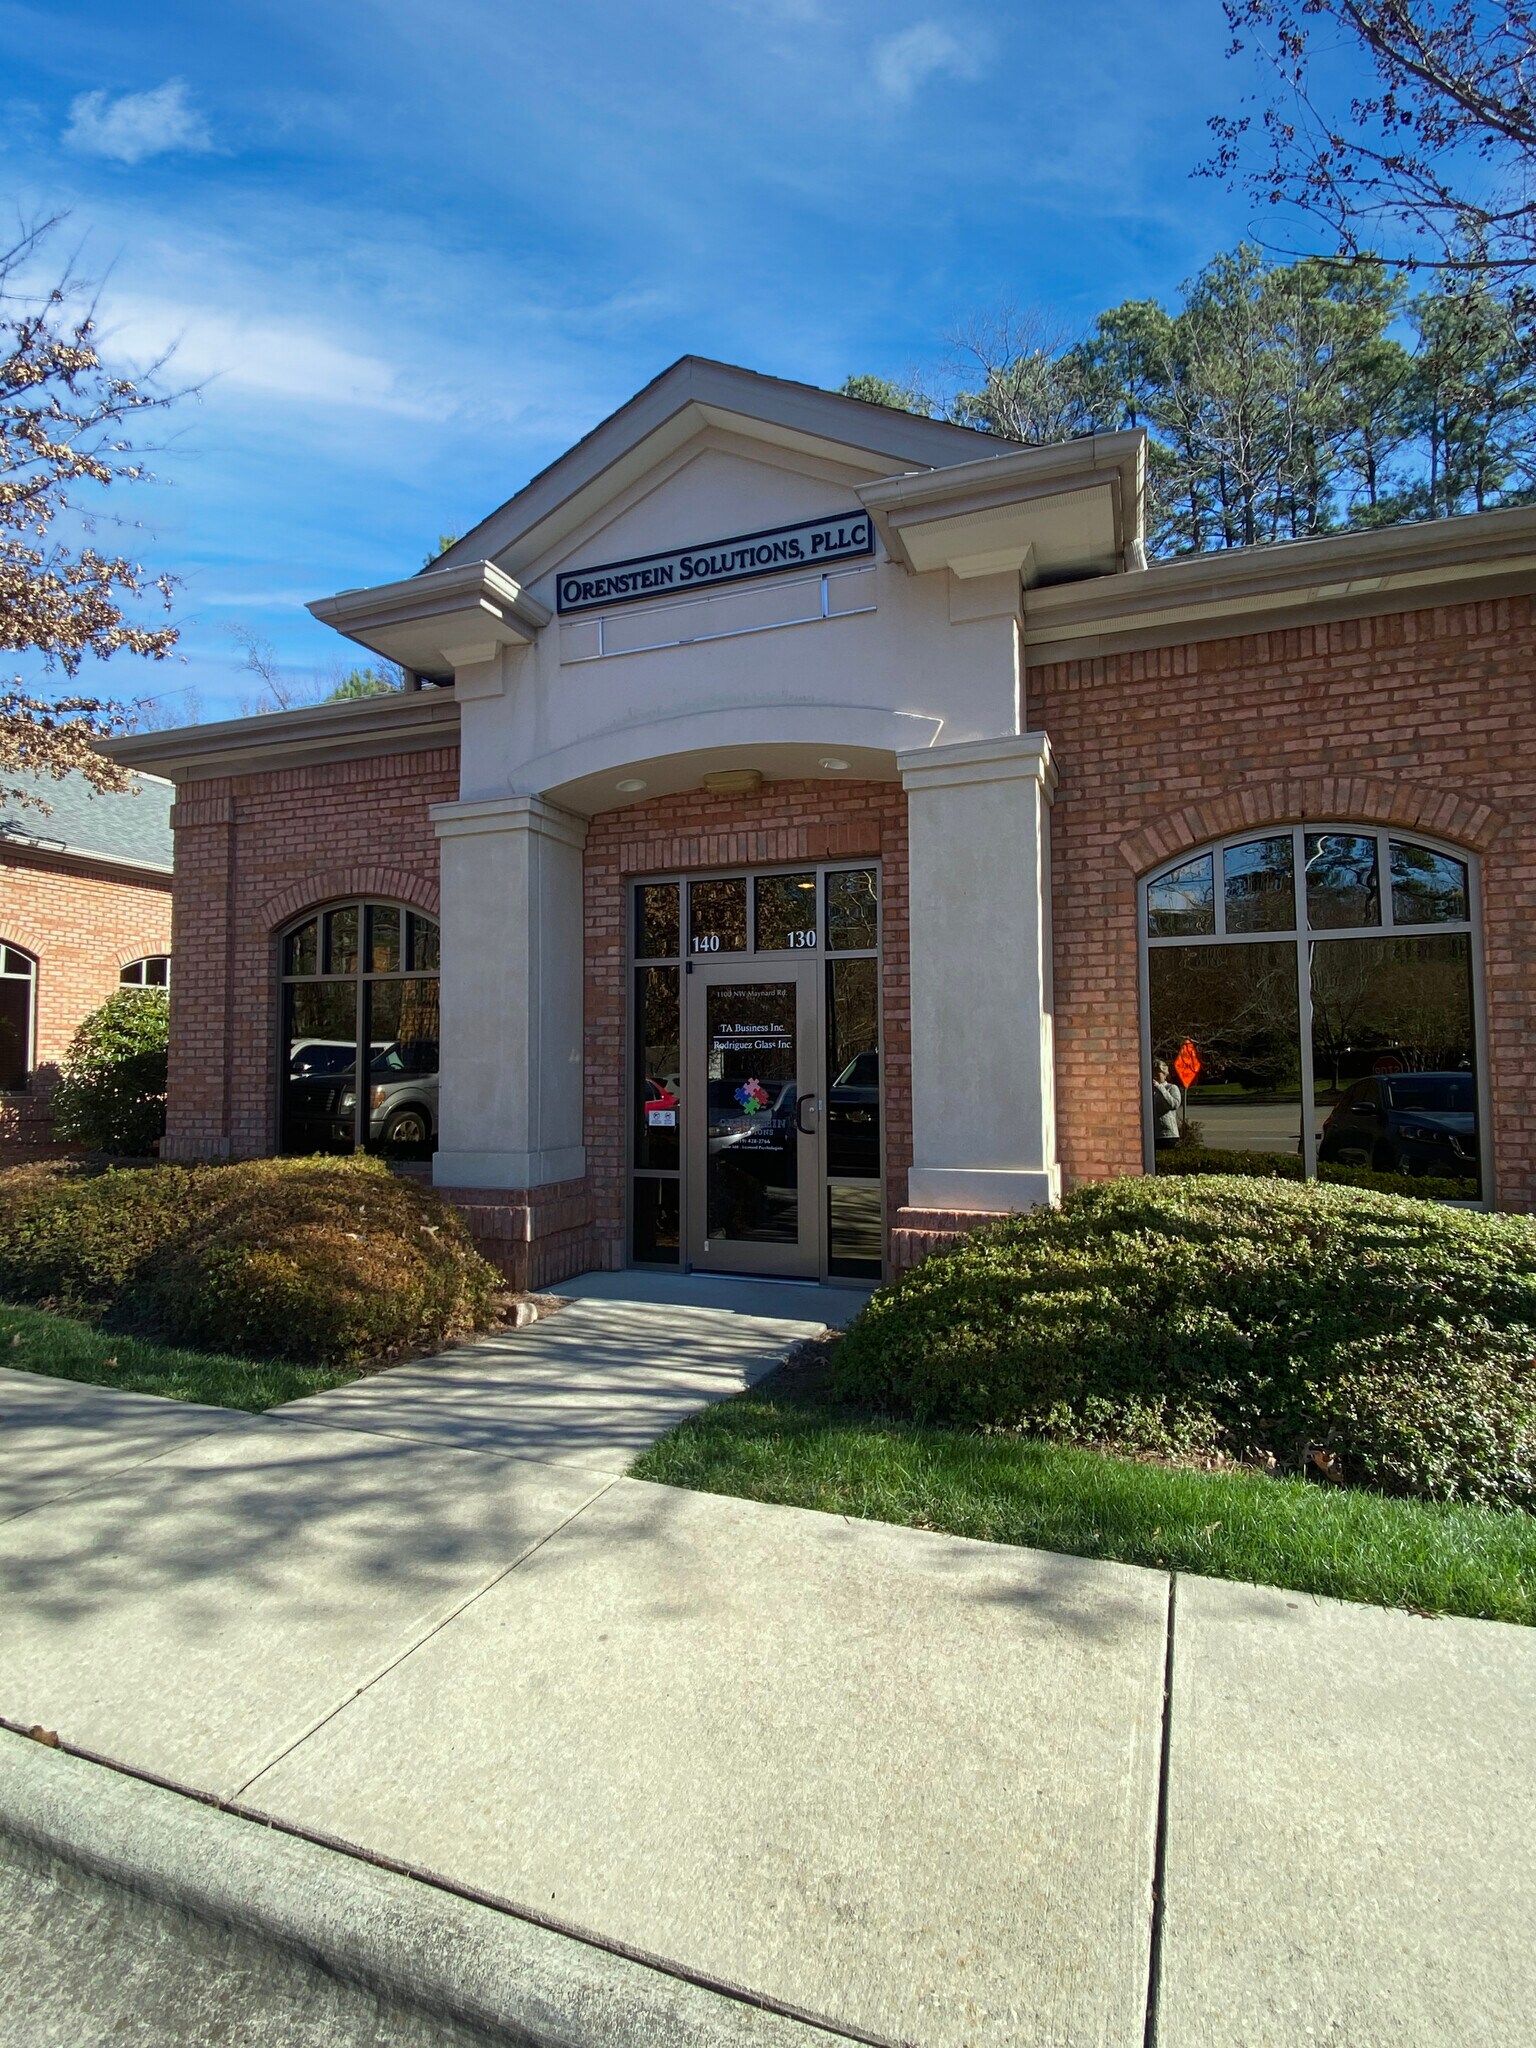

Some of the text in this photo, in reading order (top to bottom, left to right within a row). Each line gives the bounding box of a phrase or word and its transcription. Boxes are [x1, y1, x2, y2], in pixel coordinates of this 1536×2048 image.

[562, 524, 867, 603] ORENSTEIN SOLUTIONS, PLLC
[692, 935, 720, 952] 140
[787, 930, 816, 948] 130
[747, 989, 776, 999] Maynard
[720, 1023, 785, 1033] TA Business Inc.
[713, 1040, 792, 1051] Rodriguez Glass Inc.
